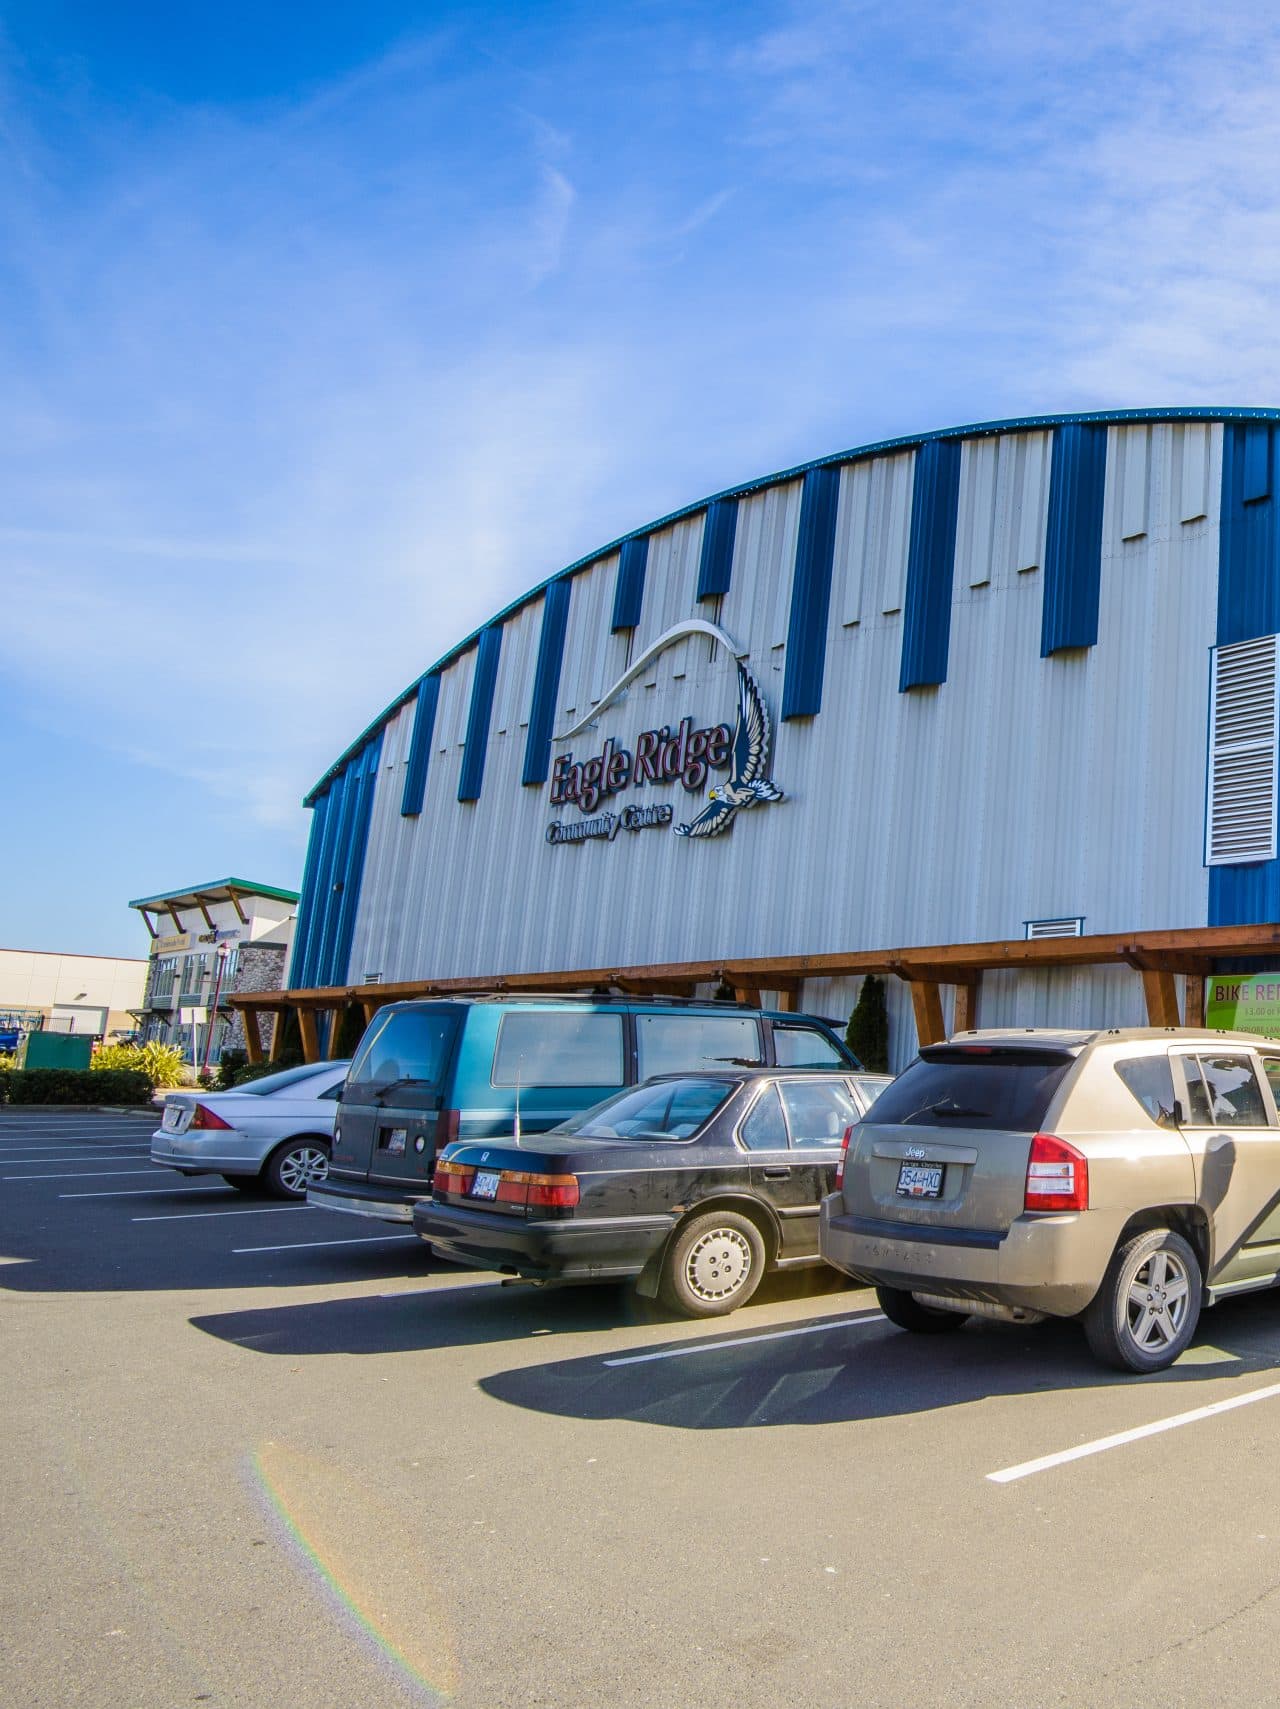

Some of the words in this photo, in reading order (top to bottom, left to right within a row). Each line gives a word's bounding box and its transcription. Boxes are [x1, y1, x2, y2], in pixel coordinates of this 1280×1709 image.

[549, 738, 631, 814] Eagle
[633, 717, 731, 792] Ridge
[545, 813, 621, 844] Community
[619, 804, 673, 831] Centre
[1215, 984, 1249, 1002] BIKE
[905, 1146, 926, 1159] Jeep
